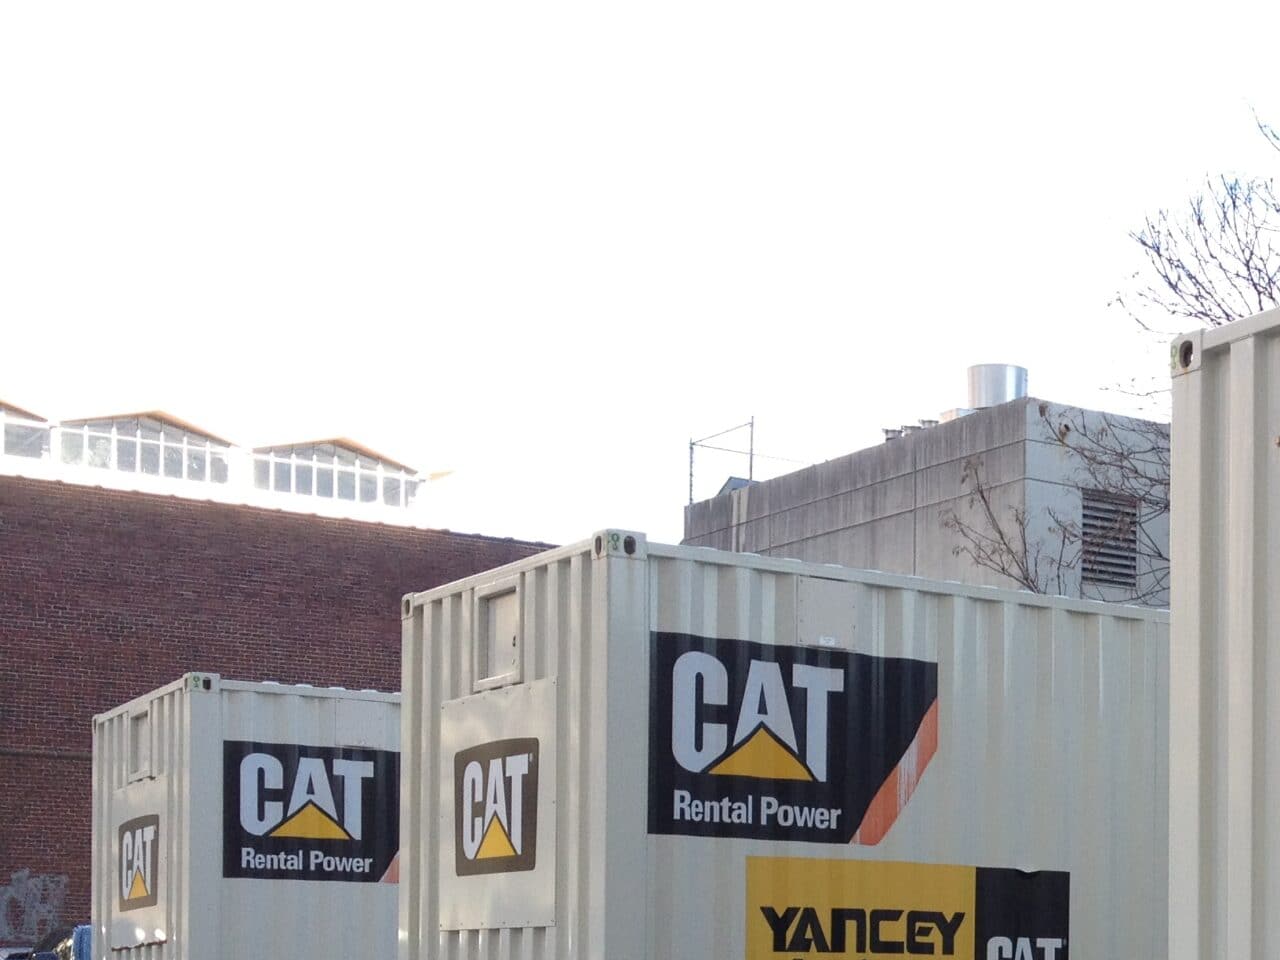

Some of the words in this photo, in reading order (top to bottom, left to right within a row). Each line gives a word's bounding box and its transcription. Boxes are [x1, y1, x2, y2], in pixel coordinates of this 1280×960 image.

[671, 650, 844, 782] CAT
[240, 753, 374, 840] CAT
[463, 753, 529, 860] CAT
[673, 789, 753, 825] Rental
[761, 796, 842, 830] Power
[122, 825, 155, 900] CAT
[241, 847, 303, 871] Rental
[310, 850, 373, 873] Power
[759, 906, 965, 955] YANCEY
